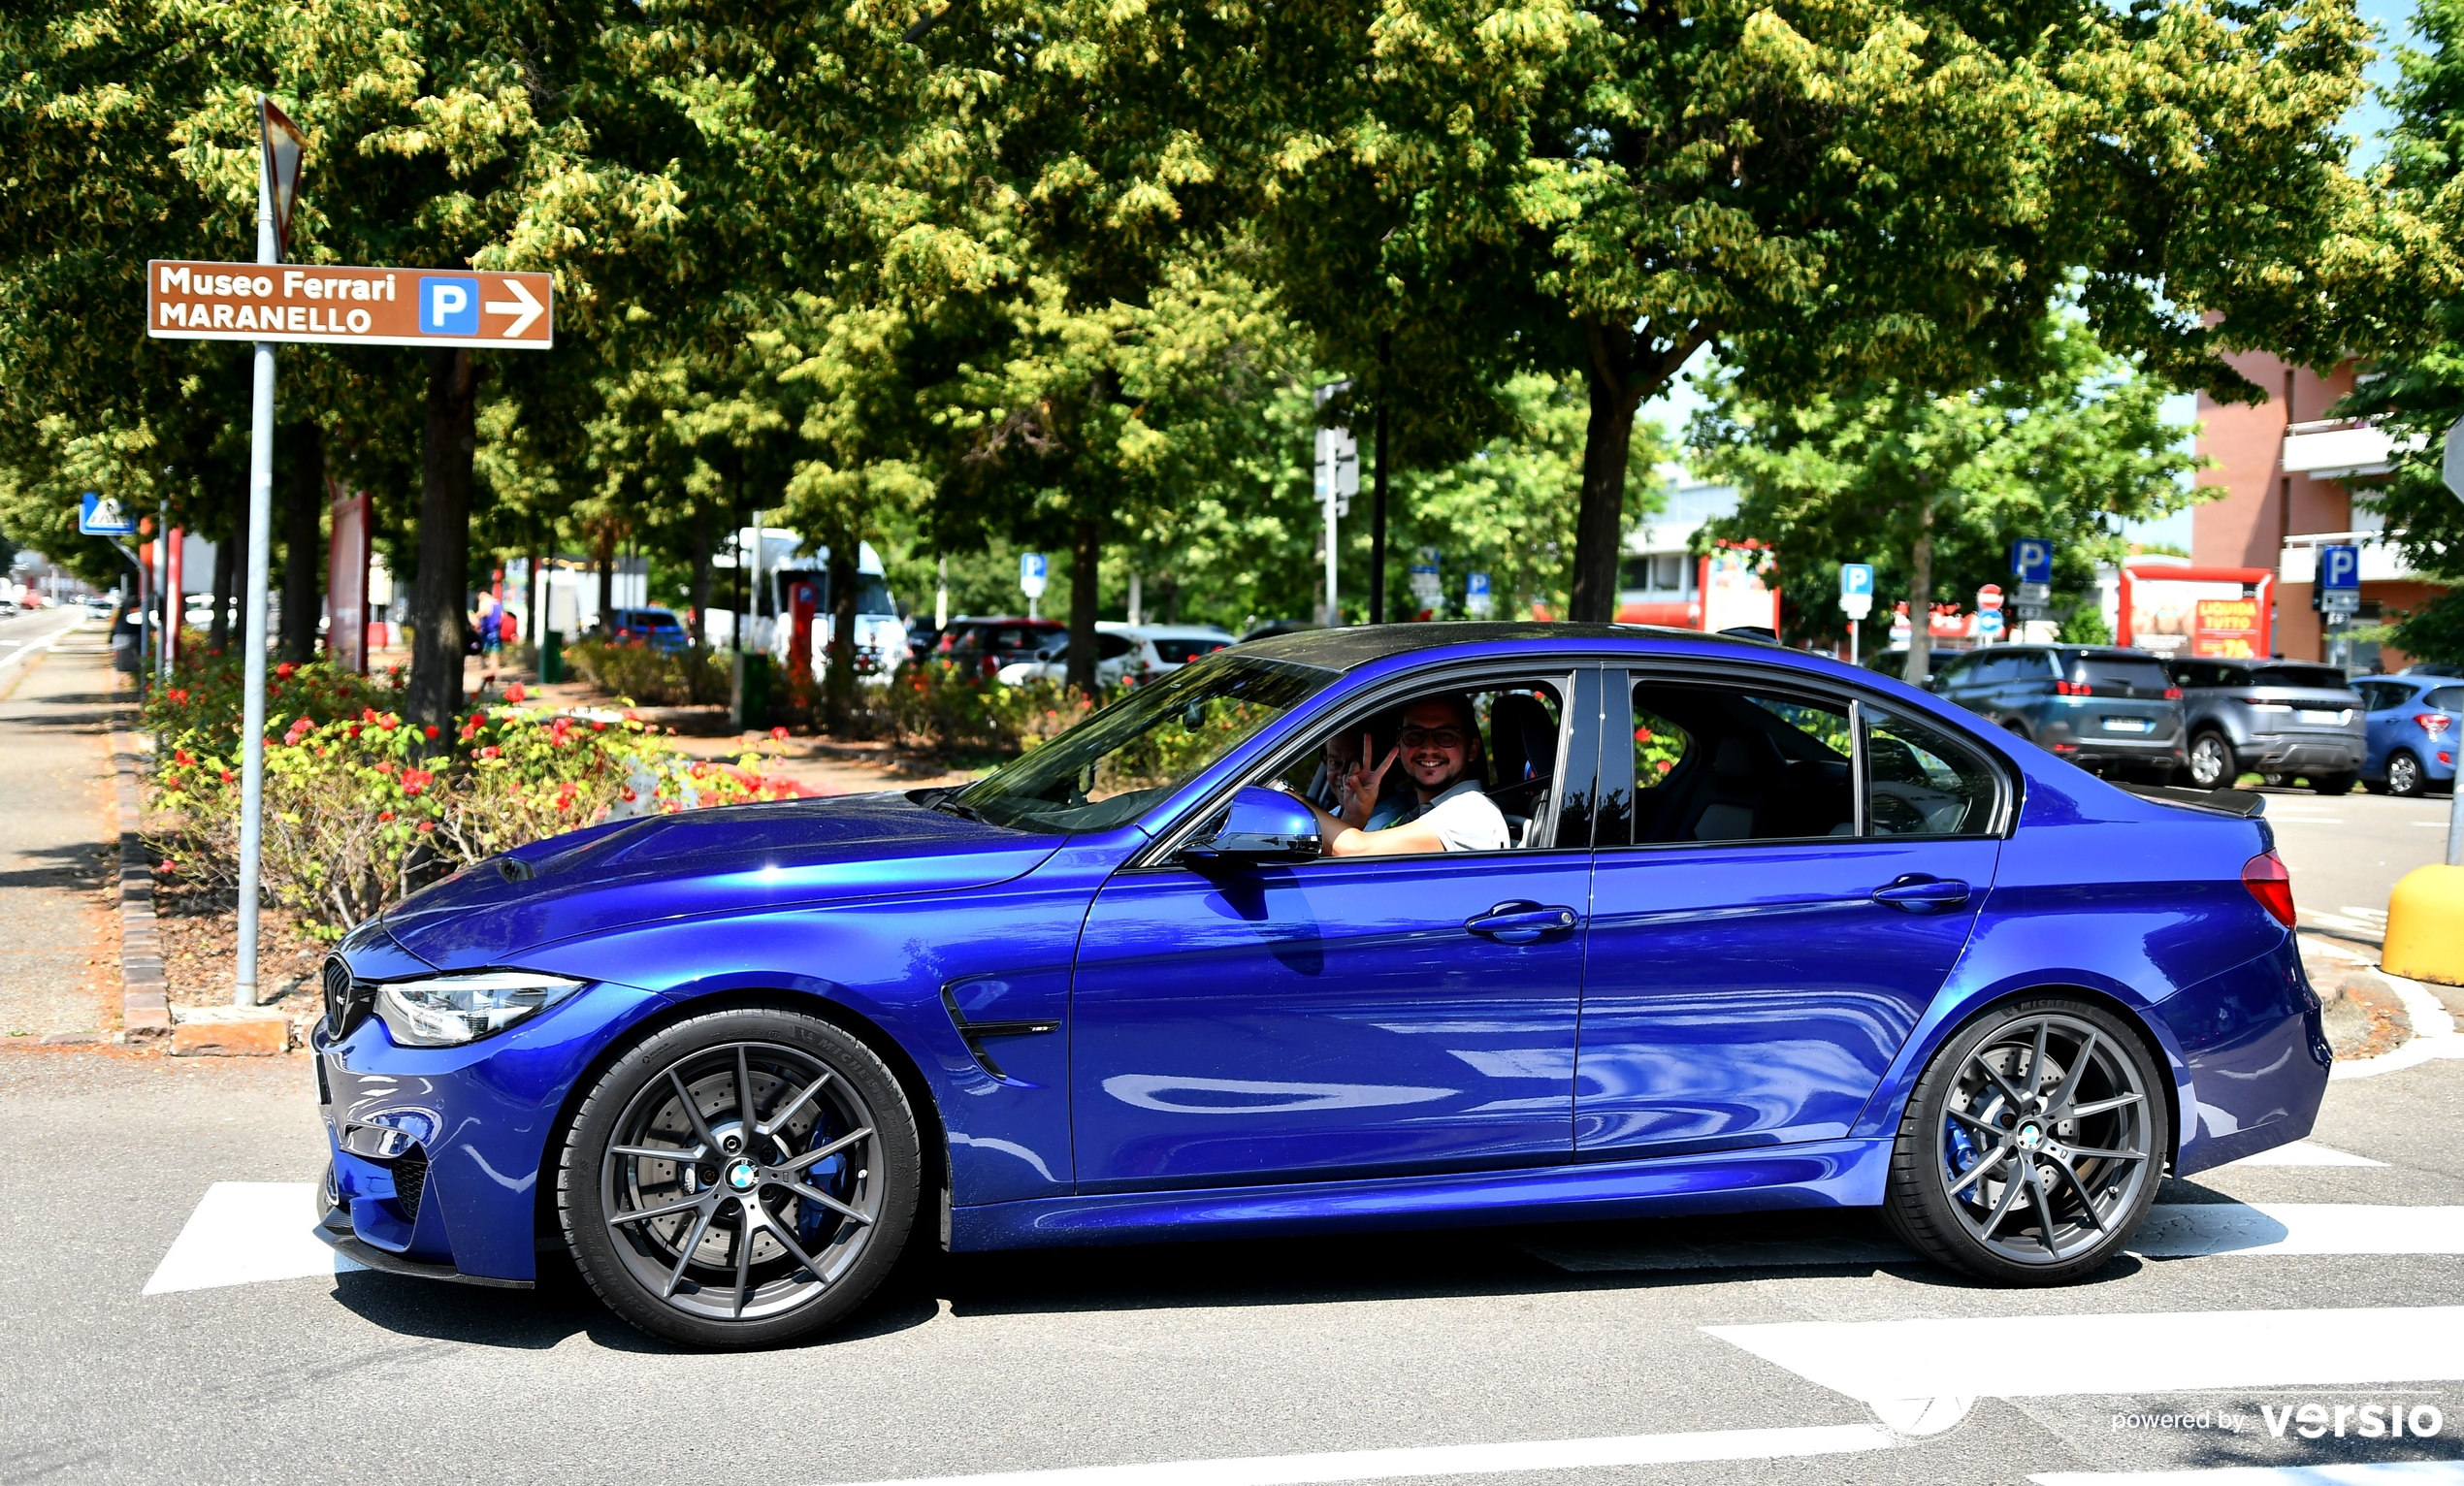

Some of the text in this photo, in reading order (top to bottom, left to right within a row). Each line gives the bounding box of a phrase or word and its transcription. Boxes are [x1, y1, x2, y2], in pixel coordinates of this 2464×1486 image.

[160, 266, 396, 302] Museo Ferrari
[160, 302, 373, 334] MARANELLO
[432, 284, 468, 327] P
[1027, 557, 1042, 576] P
[2019, 542, 2044, 576] P
[2330, 550, 2354, 585] P
[1472, 575, 1486, 593] P
[1849, 567, 1867, 592] P
[2199, 600, 2257, 616] LIQUIDA
[2204, 615, 2251, 629] TUTTO
[817, 1038, 891, 1112] MICHELIN
